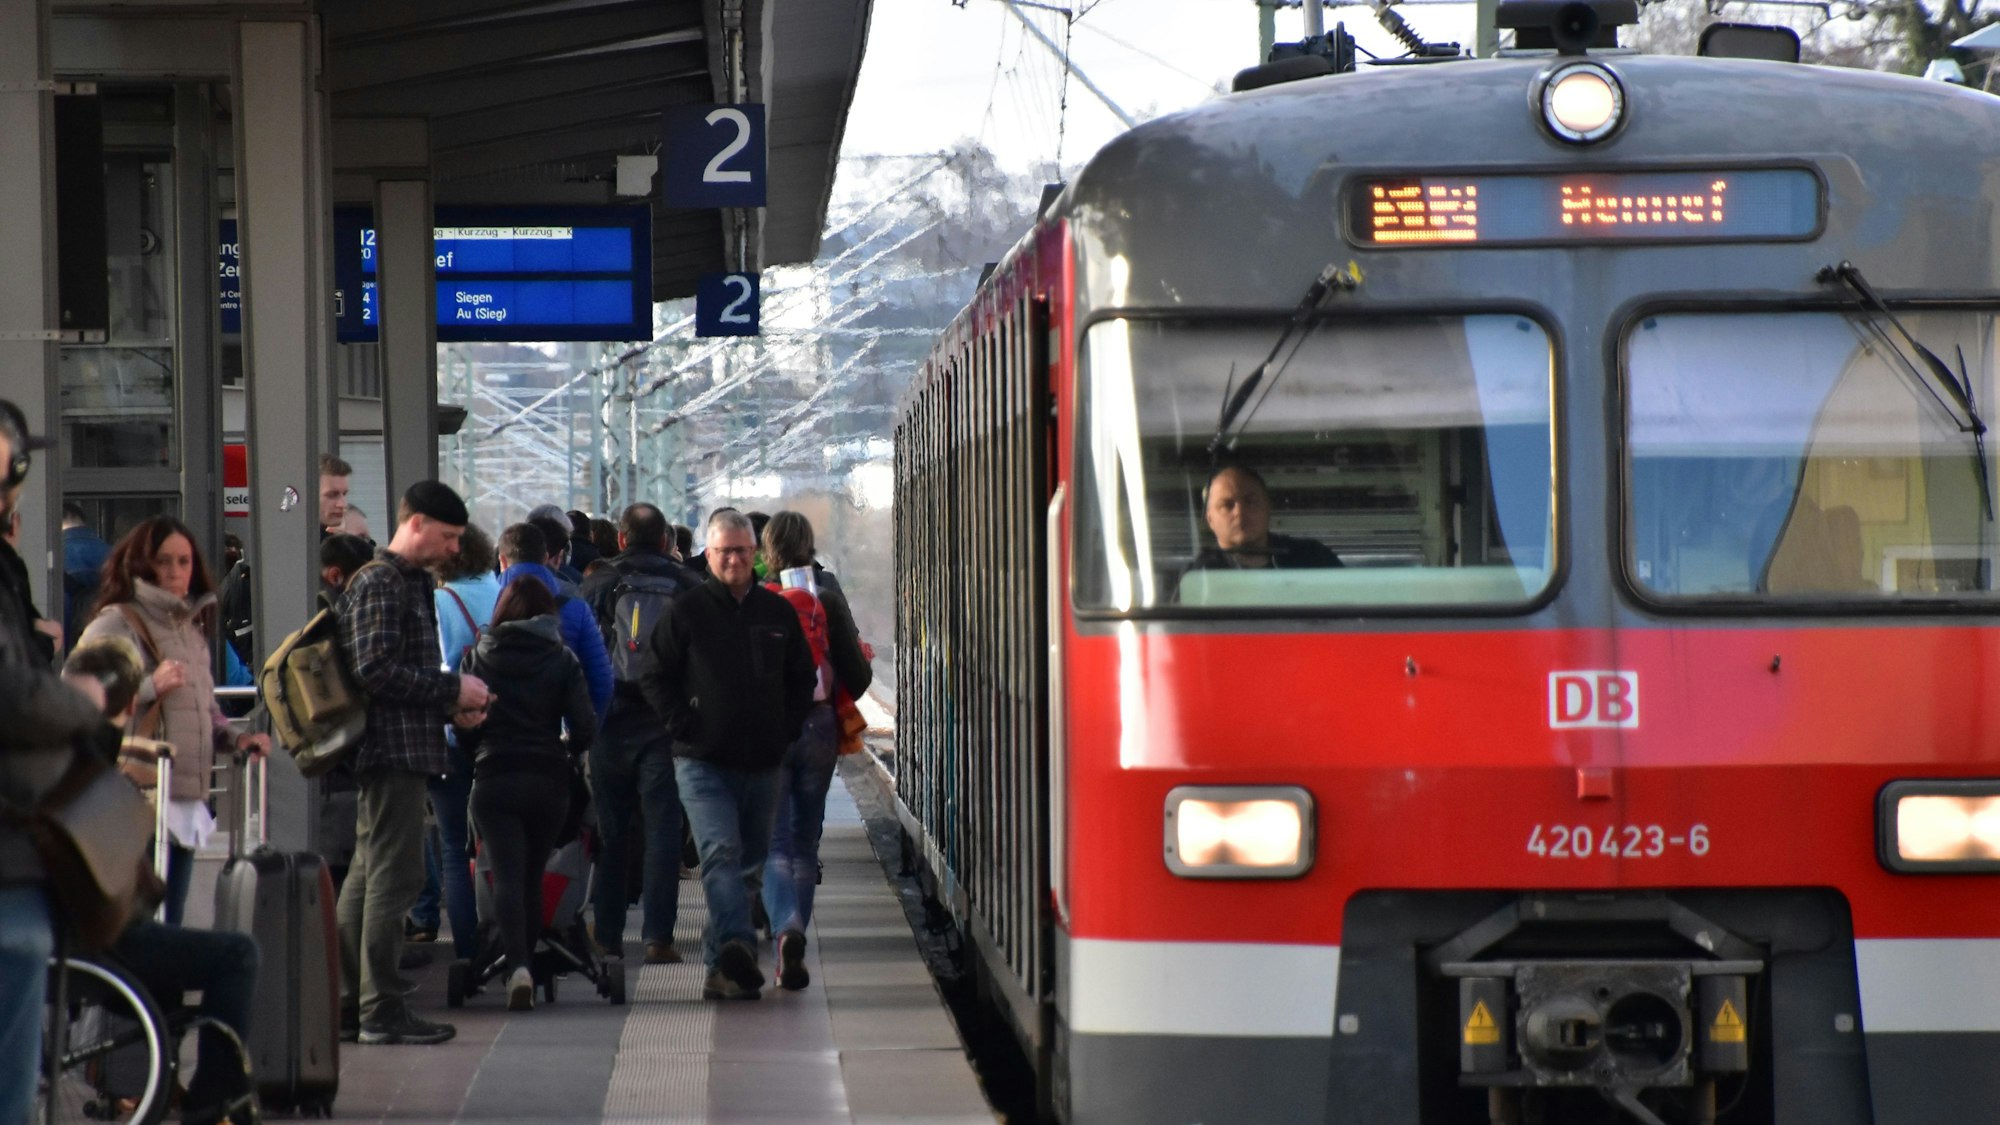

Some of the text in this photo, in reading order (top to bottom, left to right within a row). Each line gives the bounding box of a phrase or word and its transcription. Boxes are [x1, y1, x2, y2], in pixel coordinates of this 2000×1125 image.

[704, 107, 752, 183] 2
[458, 227, 498, 238] Kurzzug
[512, 227, 553, 238] Kurzzug
[434, 252, 453, 268] ef
[455, 291, 493, 305] Siegen
[718, 274, 752, 324] 2
[362, 308, 371, 319] 2
[456, 308, 506, 321] Au (Sieg)
[1553, 673, 1635, 726] DB
